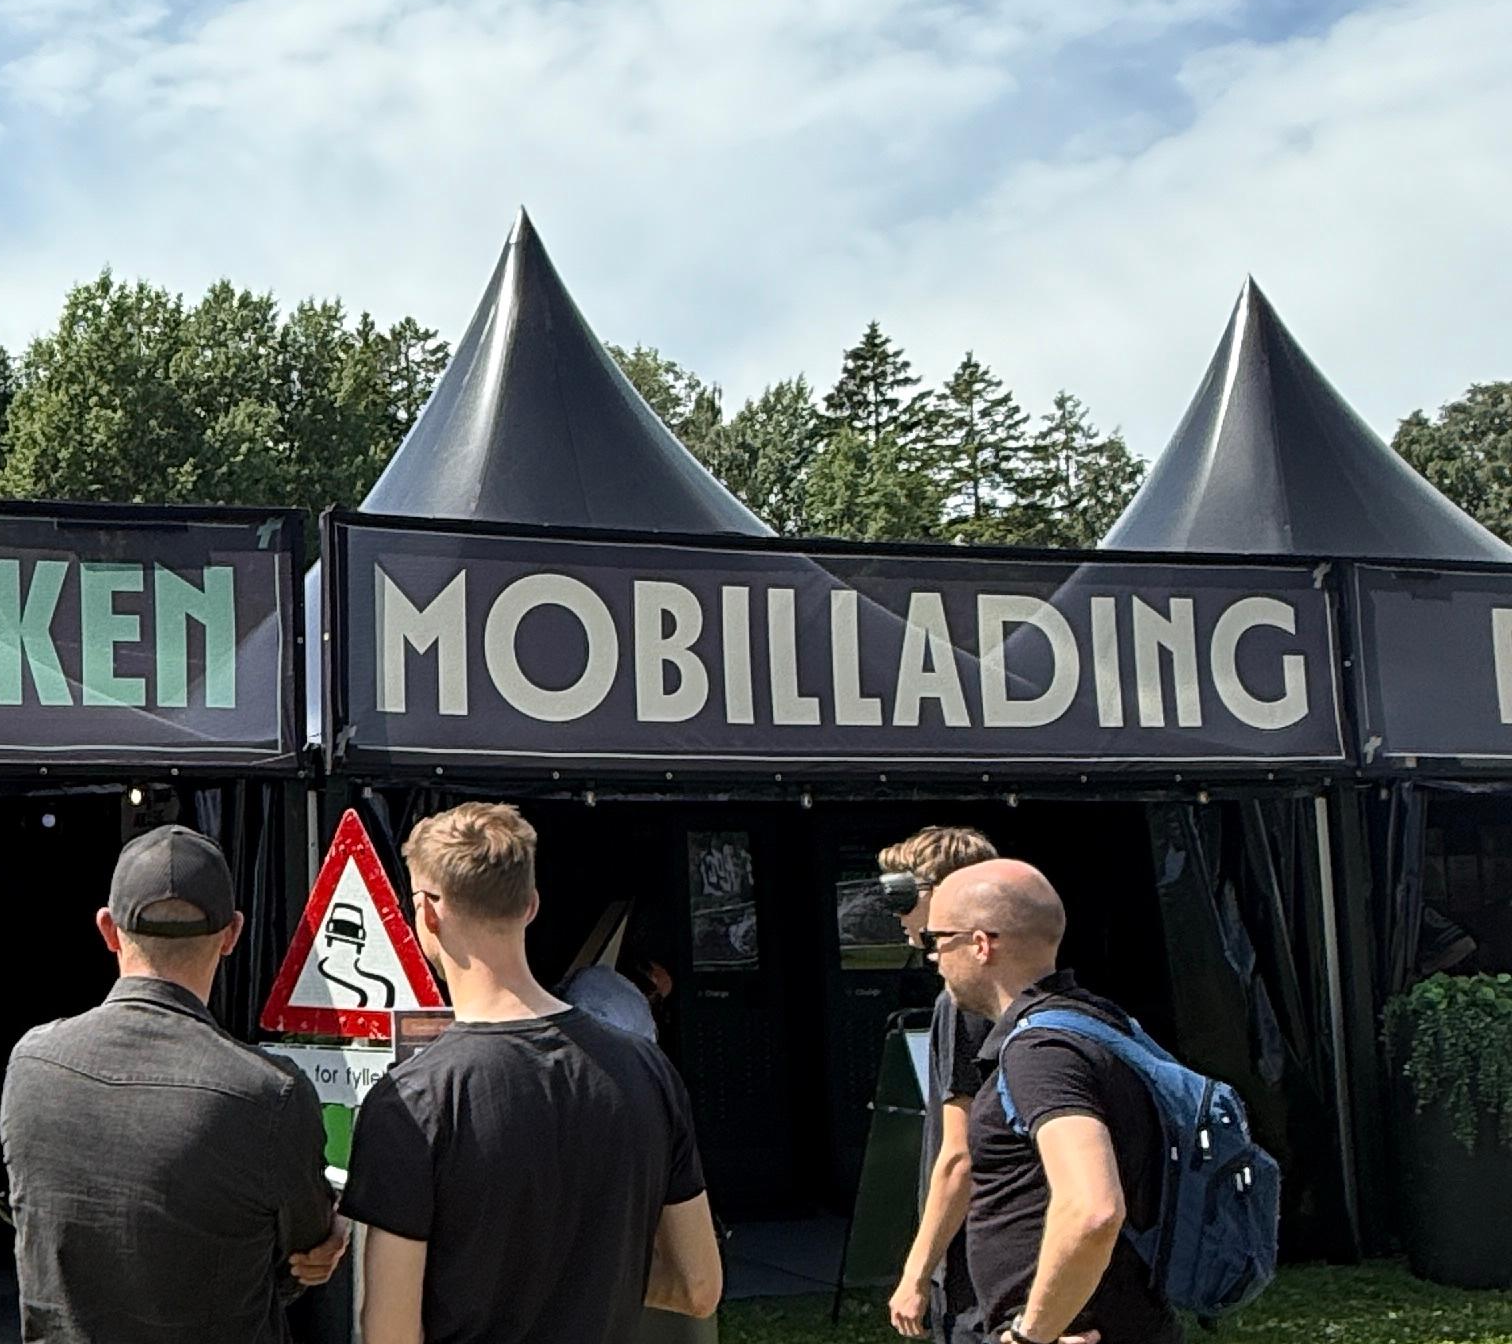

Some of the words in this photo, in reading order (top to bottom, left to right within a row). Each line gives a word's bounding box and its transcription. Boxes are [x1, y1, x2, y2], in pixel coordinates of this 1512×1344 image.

[373, 561, 1309, 731] MOBILLADING
[315, 1064, 338, 1084] for
[345, 1066, 386, 1089] fylle
